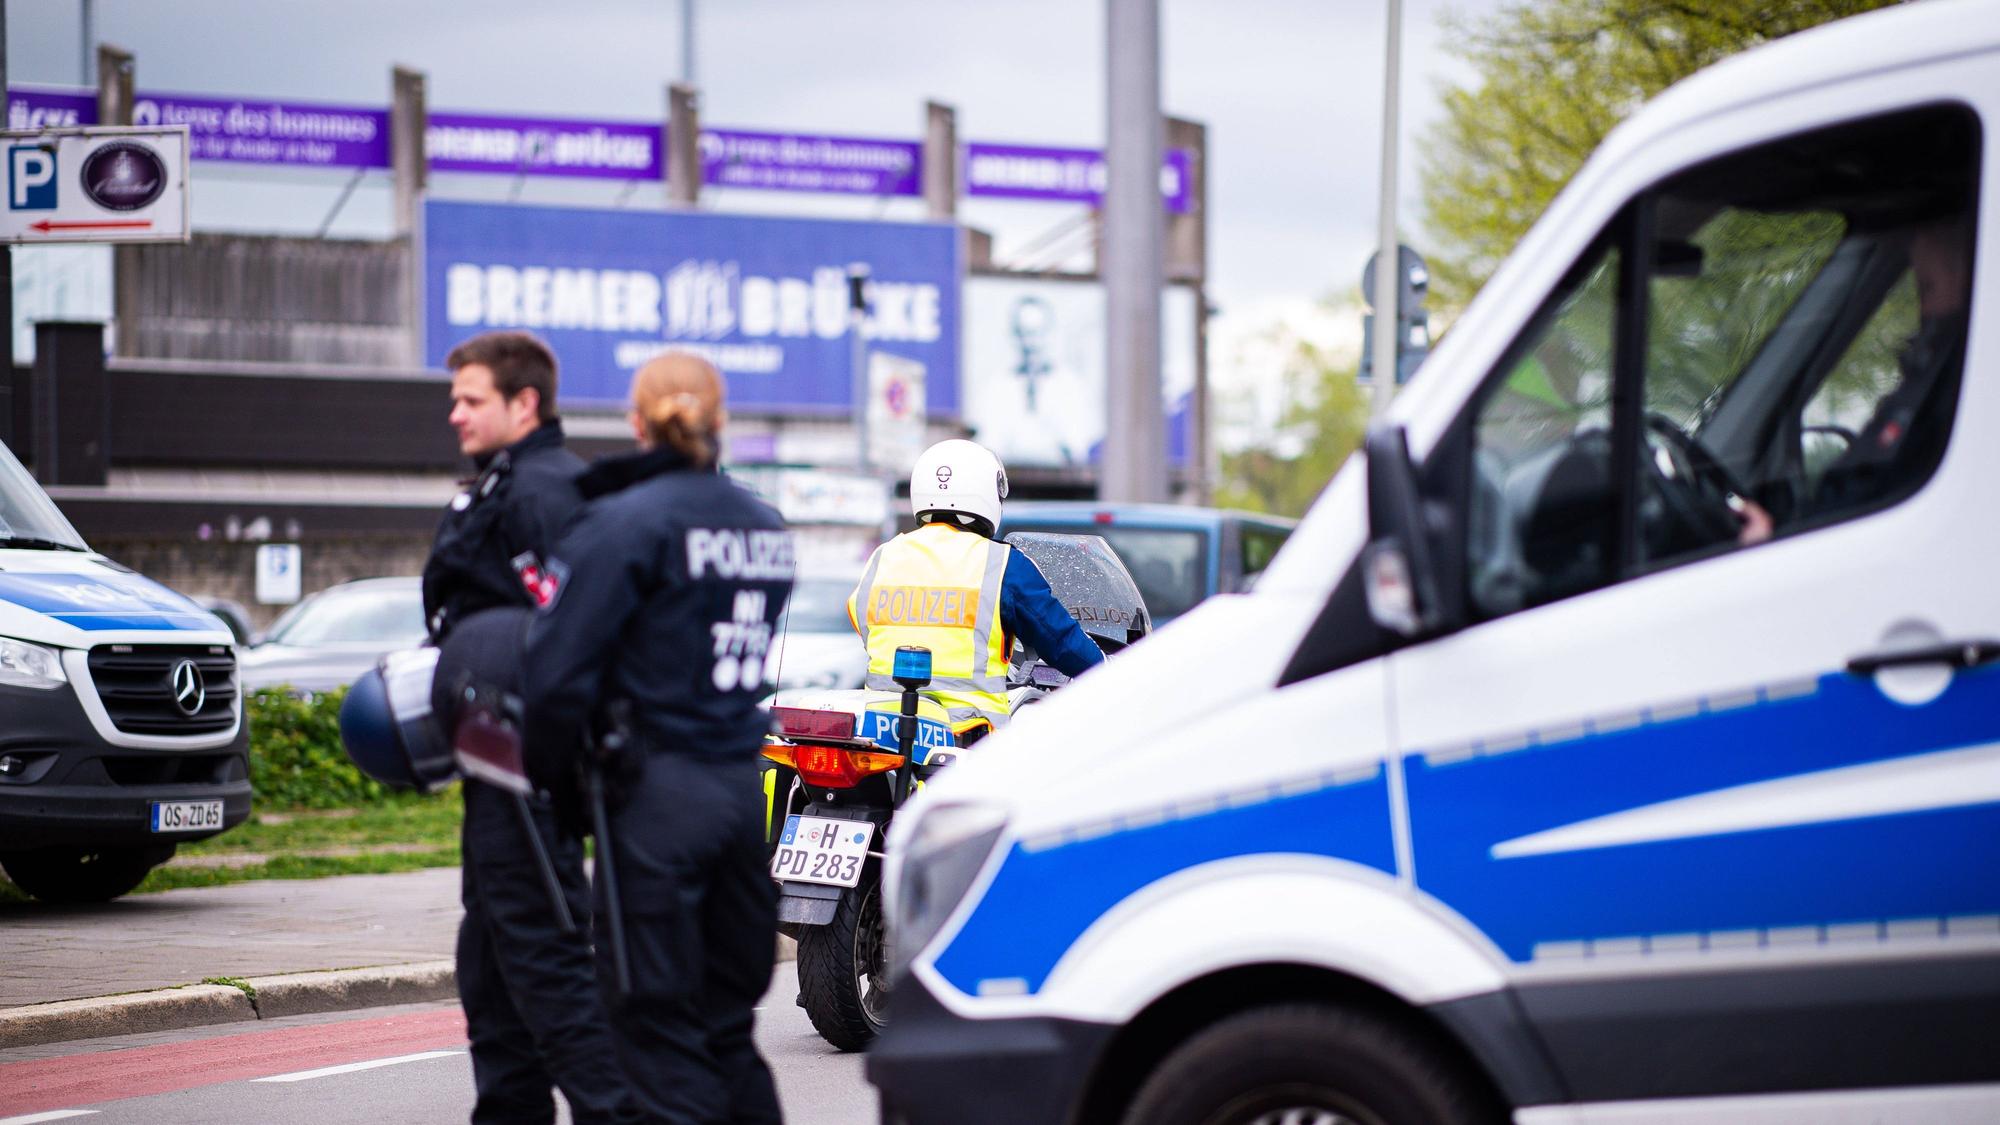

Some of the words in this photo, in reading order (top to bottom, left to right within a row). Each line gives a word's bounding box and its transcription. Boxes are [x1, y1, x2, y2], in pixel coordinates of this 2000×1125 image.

[15, 149, 54, 206] P
[447, 262, 662, 333] BREMER
[686, 527, 796, 580] POLIZE
[875, 588, 967, 625] POLIZEI
[876, 714, 948, 748] POIZEI
[164, 804, 182, 827] OS
[189, 803, 205, 826] ZD
[206, 802, 219, 825] 65
[819, 823, 839, 849] H
[775, 848, 808, 875] PD
[810, 852, 860, 881] 283
